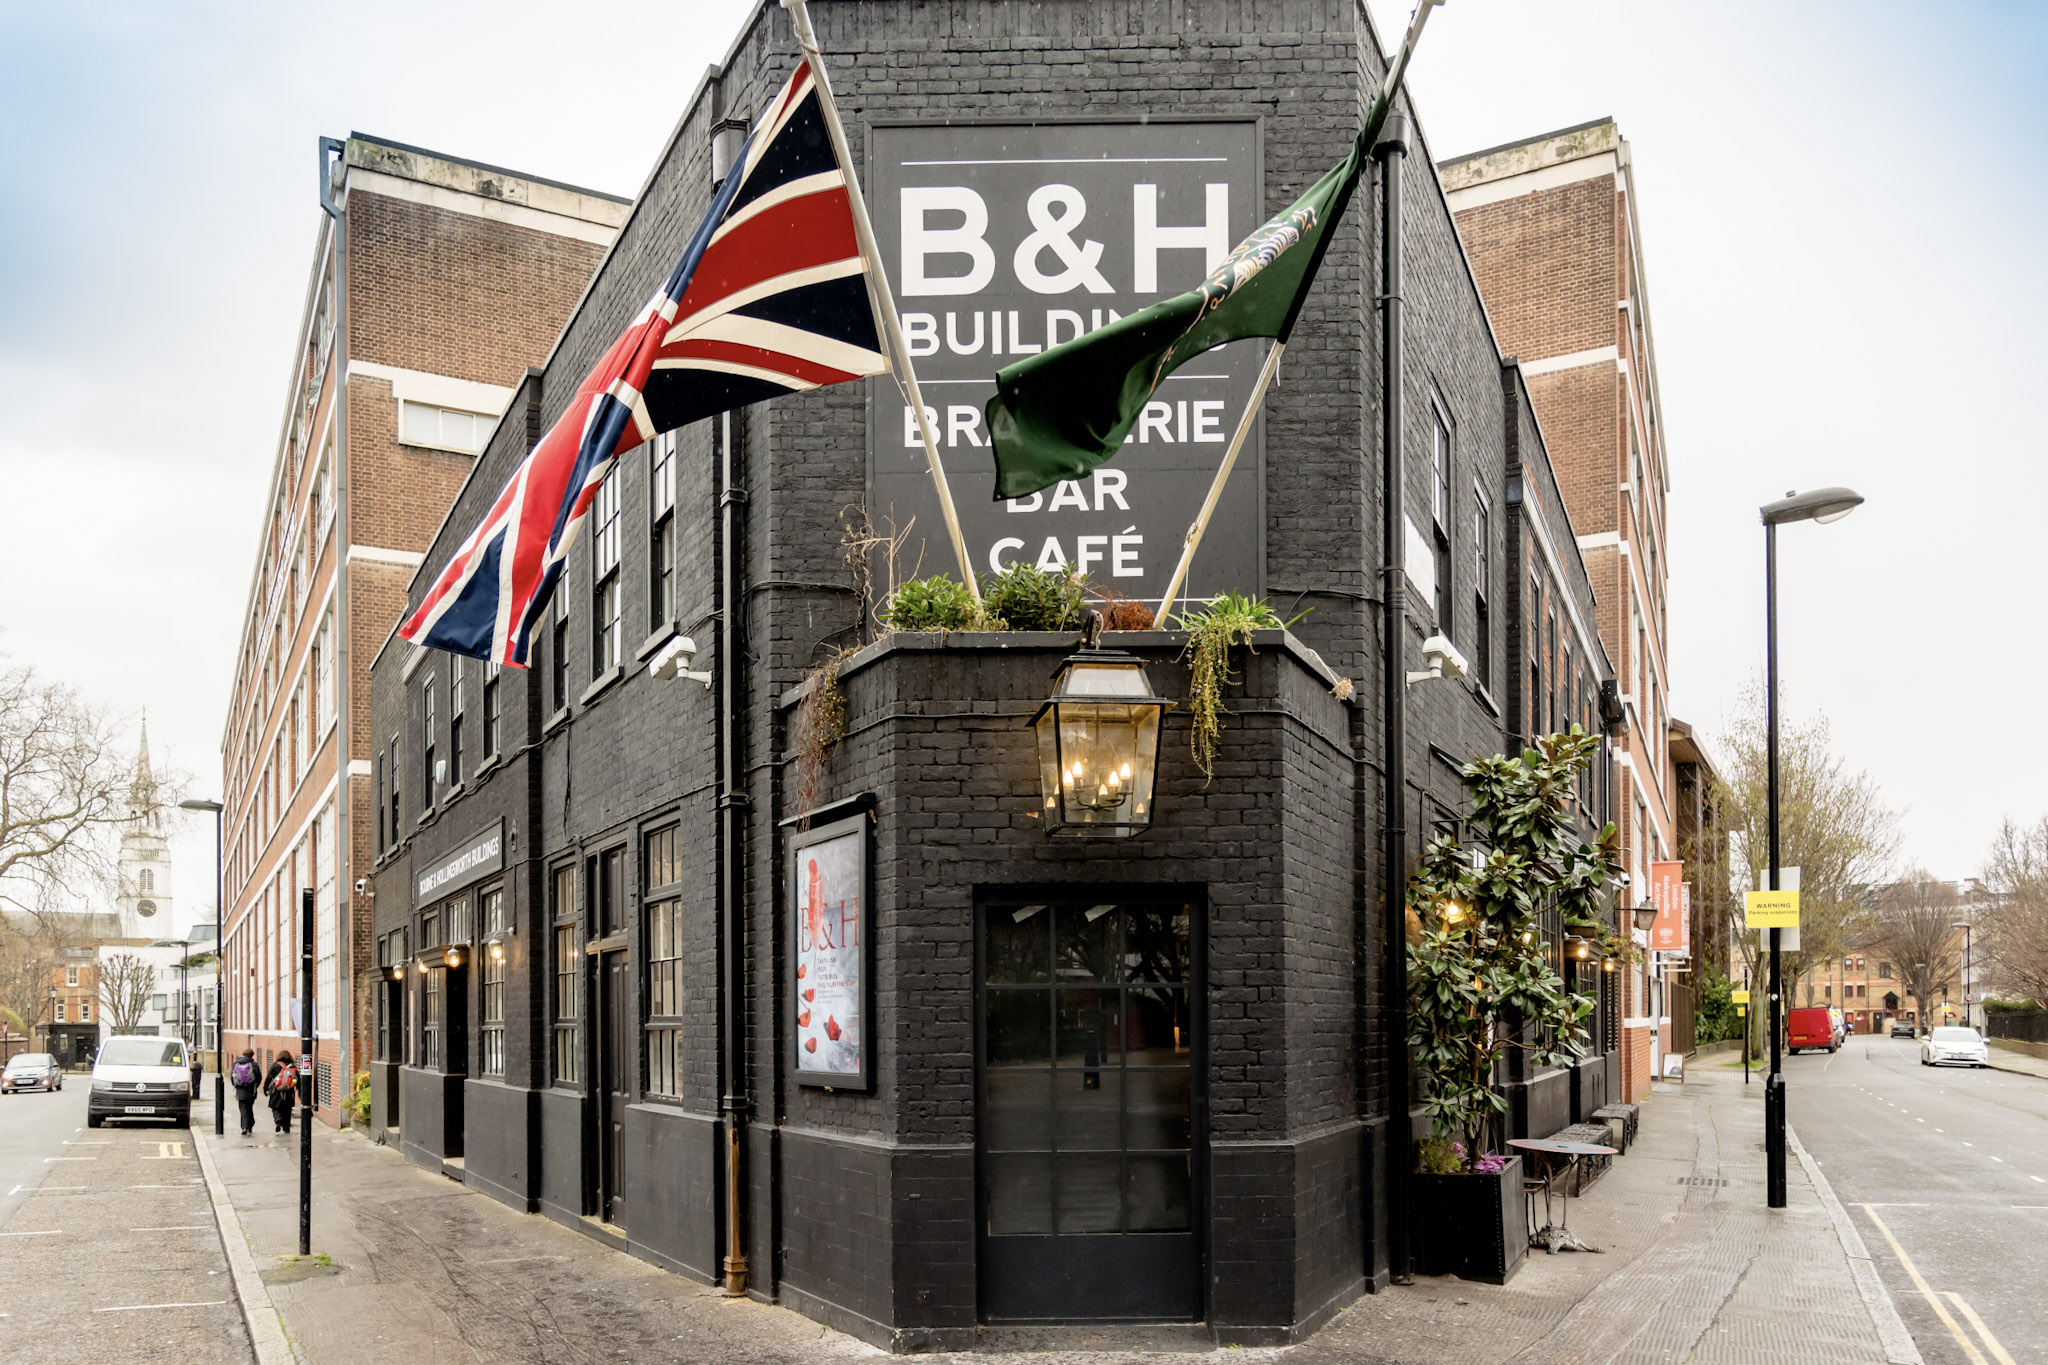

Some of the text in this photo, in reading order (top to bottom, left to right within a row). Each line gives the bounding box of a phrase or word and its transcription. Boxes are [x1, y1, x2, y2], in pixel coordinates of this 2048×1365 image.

[901, 309, 1228, 357] BUILD
[904, 401, 1225, 448] BRARIE
[989, 524, 1144, 578] CAFÉ
[471, 836, 499, 867] BUILDINGS
